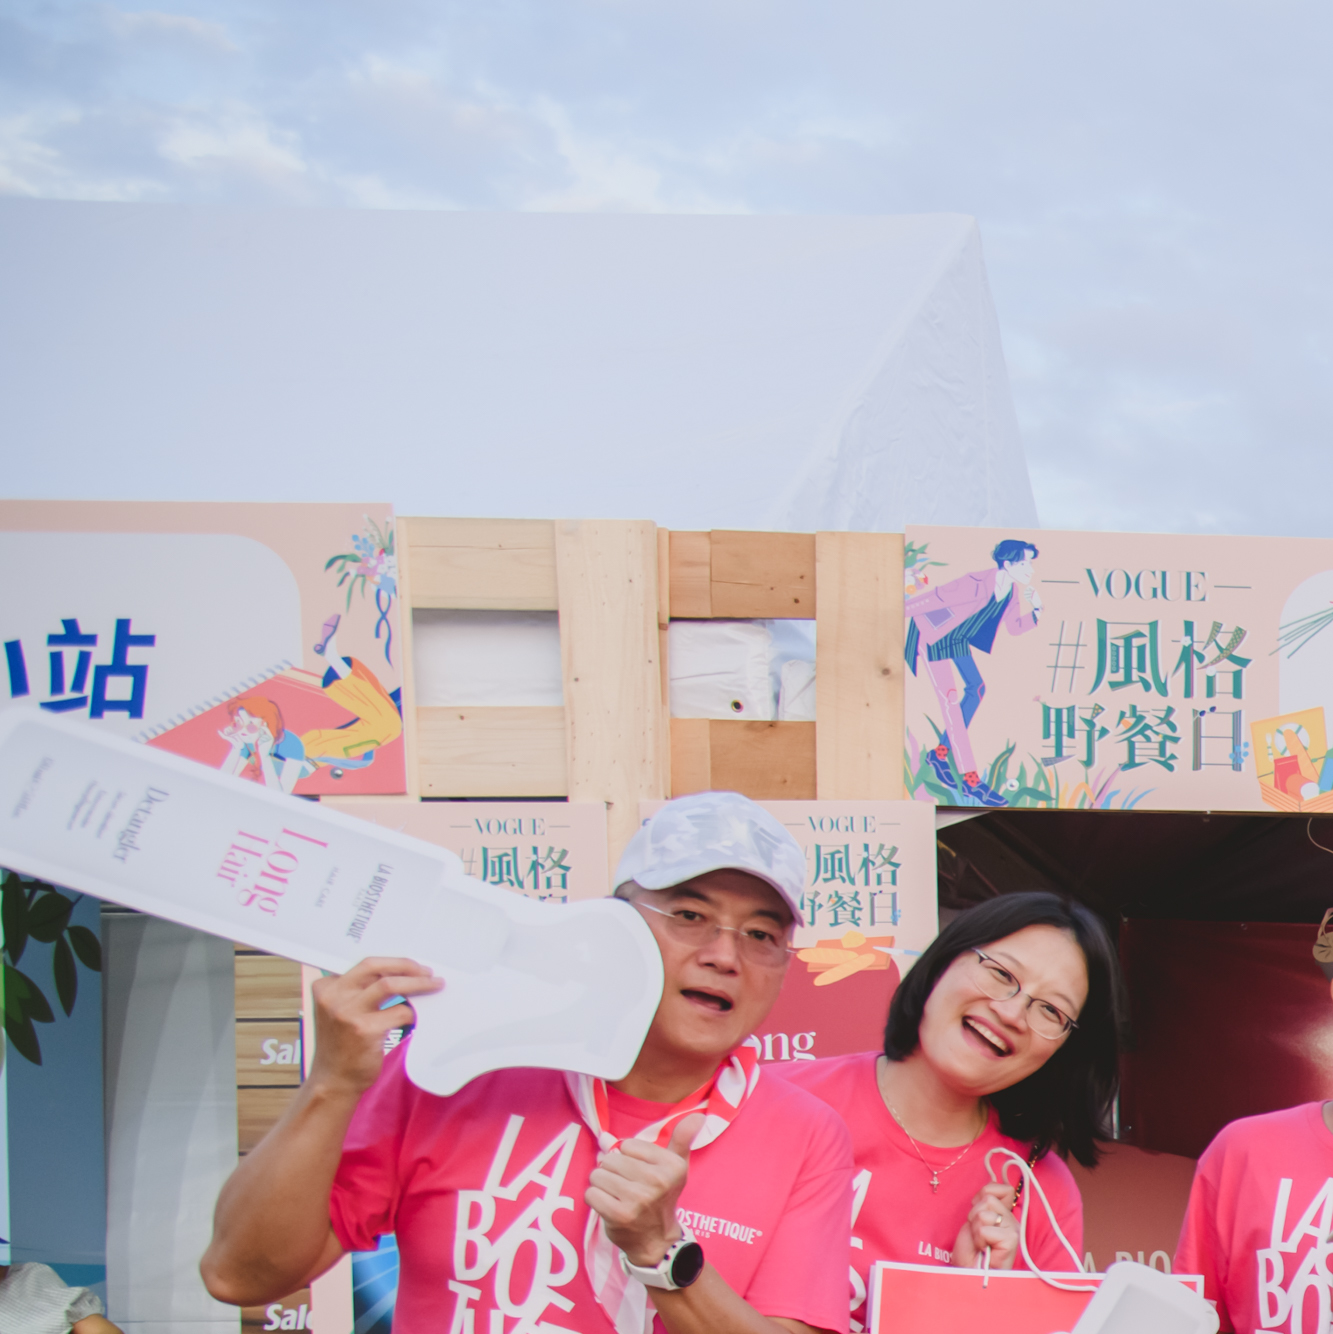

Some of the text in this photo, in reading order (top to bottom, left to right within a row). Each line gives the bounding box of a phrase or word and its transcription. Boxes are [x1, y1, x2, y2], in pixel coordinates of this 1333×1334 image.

[1085, 568, 1207, 601] VOGUE
[2, 617, 156, 720] 站
[1040, 703, 1244, 773] 野餐日
[113, 786, 170, 863] Detangler
[474, 818, 546, 836] VOGUE
[809, 816, 876, 833] VOGUE
[217, 830, 270, 888] Hair
[239, 827, 329, 918] Long
[482, 1114, 581, 1201] LA
[918, 1241, 933, 1257] LA
